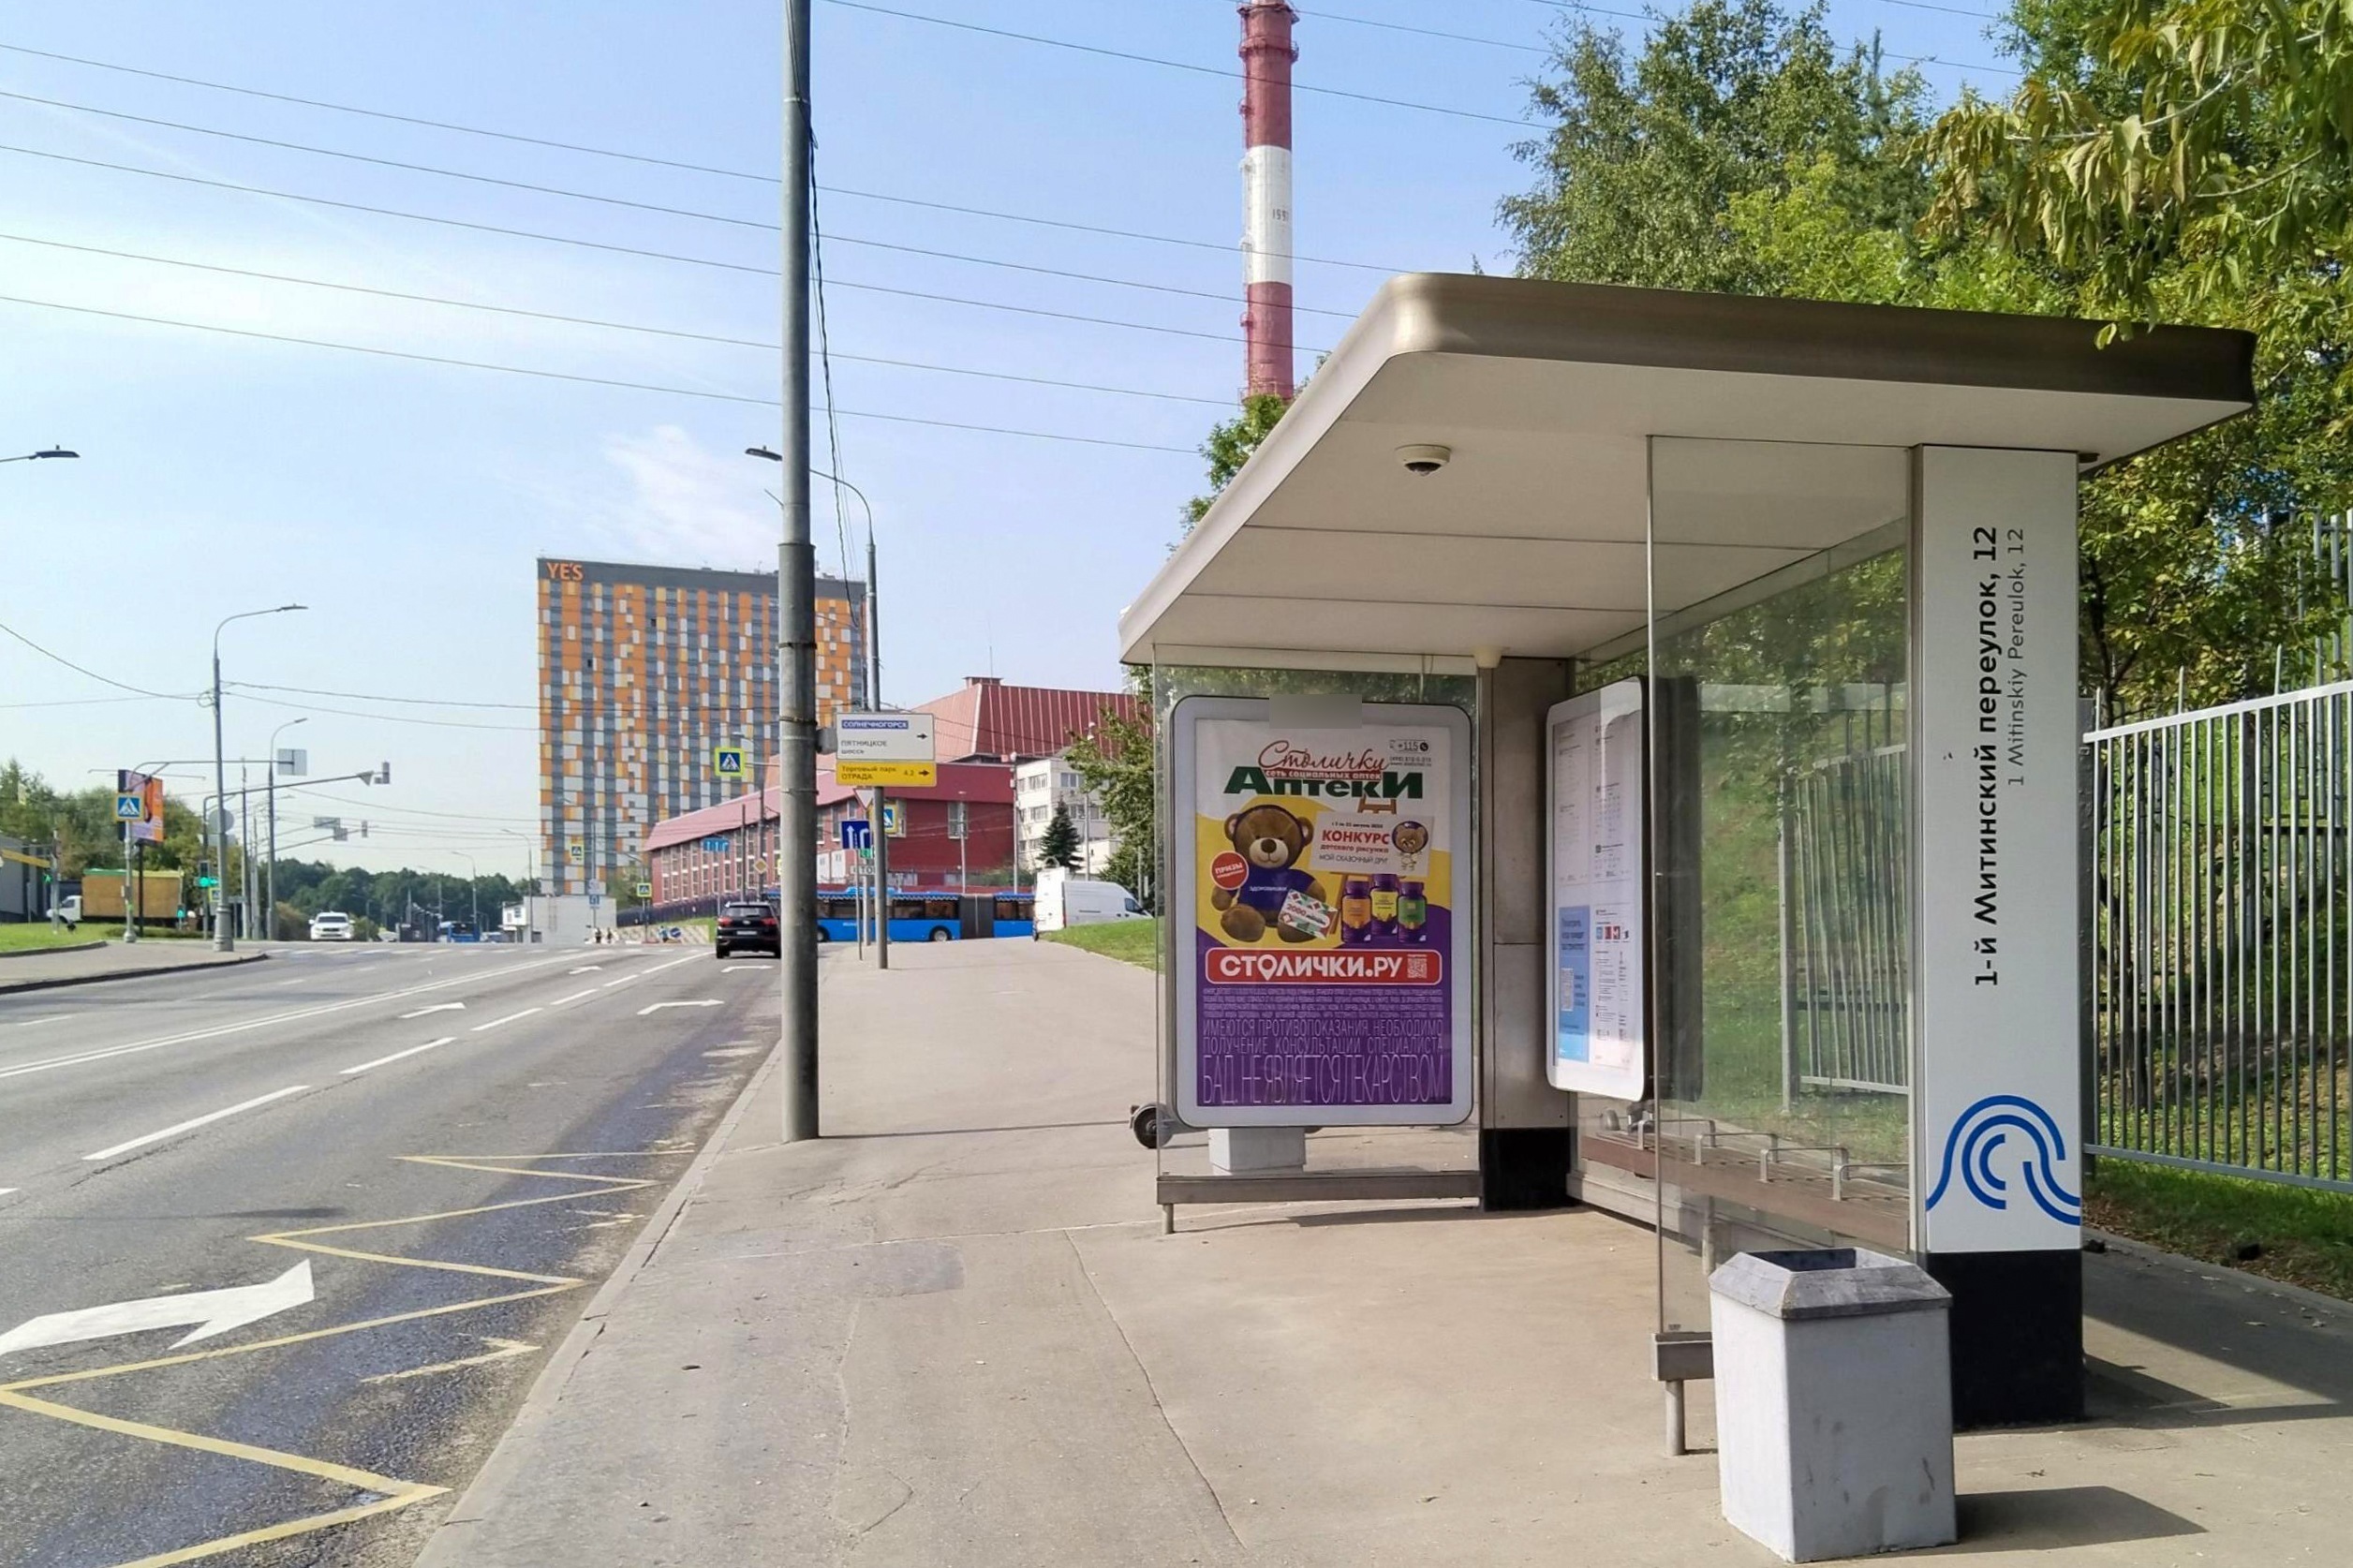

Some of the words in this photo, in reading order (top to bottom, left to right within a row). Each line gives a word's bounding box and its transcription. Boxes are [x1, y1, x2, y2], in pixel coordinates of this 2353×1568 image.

[1972, 526, 1997, 562] 12
[2006, 528, 2024, 555] 12
[2005, 562, 2028, 659] Pereulok,
[1978, 572, 2003, 733] переулок,
[2005, 668, 2028, 767] Mitinskiy
[1258, 740, 1390, 771] Столички
[1288, 771, 1350, 779] социальных
[2007, 776, 2024, 786] 1
[1322, 830, 1390, 845] КОНКУРС
[1973, 745, 1997, 925] Митинский
[1220, 954, 1402, 981] СТОЛИЧКИ.РУ
[1974, 938, 1998, 986] 1-й
[1203, 1018, 1255, 1036] ИМЕЮТСЯ
[1373, 1018, 1443, 1037] НЕОБХОДИМО
[1203, 1037, 1268, 1055] ПОЛУЧЕНИЕ
[1275, 1037, 1361, 1055] КОНСУЛЬТАЦИИ
[1367, 1037, 1443, 1055] СПЕЦИАЛИСТА
[1241, 1055, 1262, 1103] НЕ
[1264, 1055, 1340, 1103] ЯВЛЯЕТСЯ
[1342, 1055, 1443, 1103] ЛЕКАРСТВОМ
